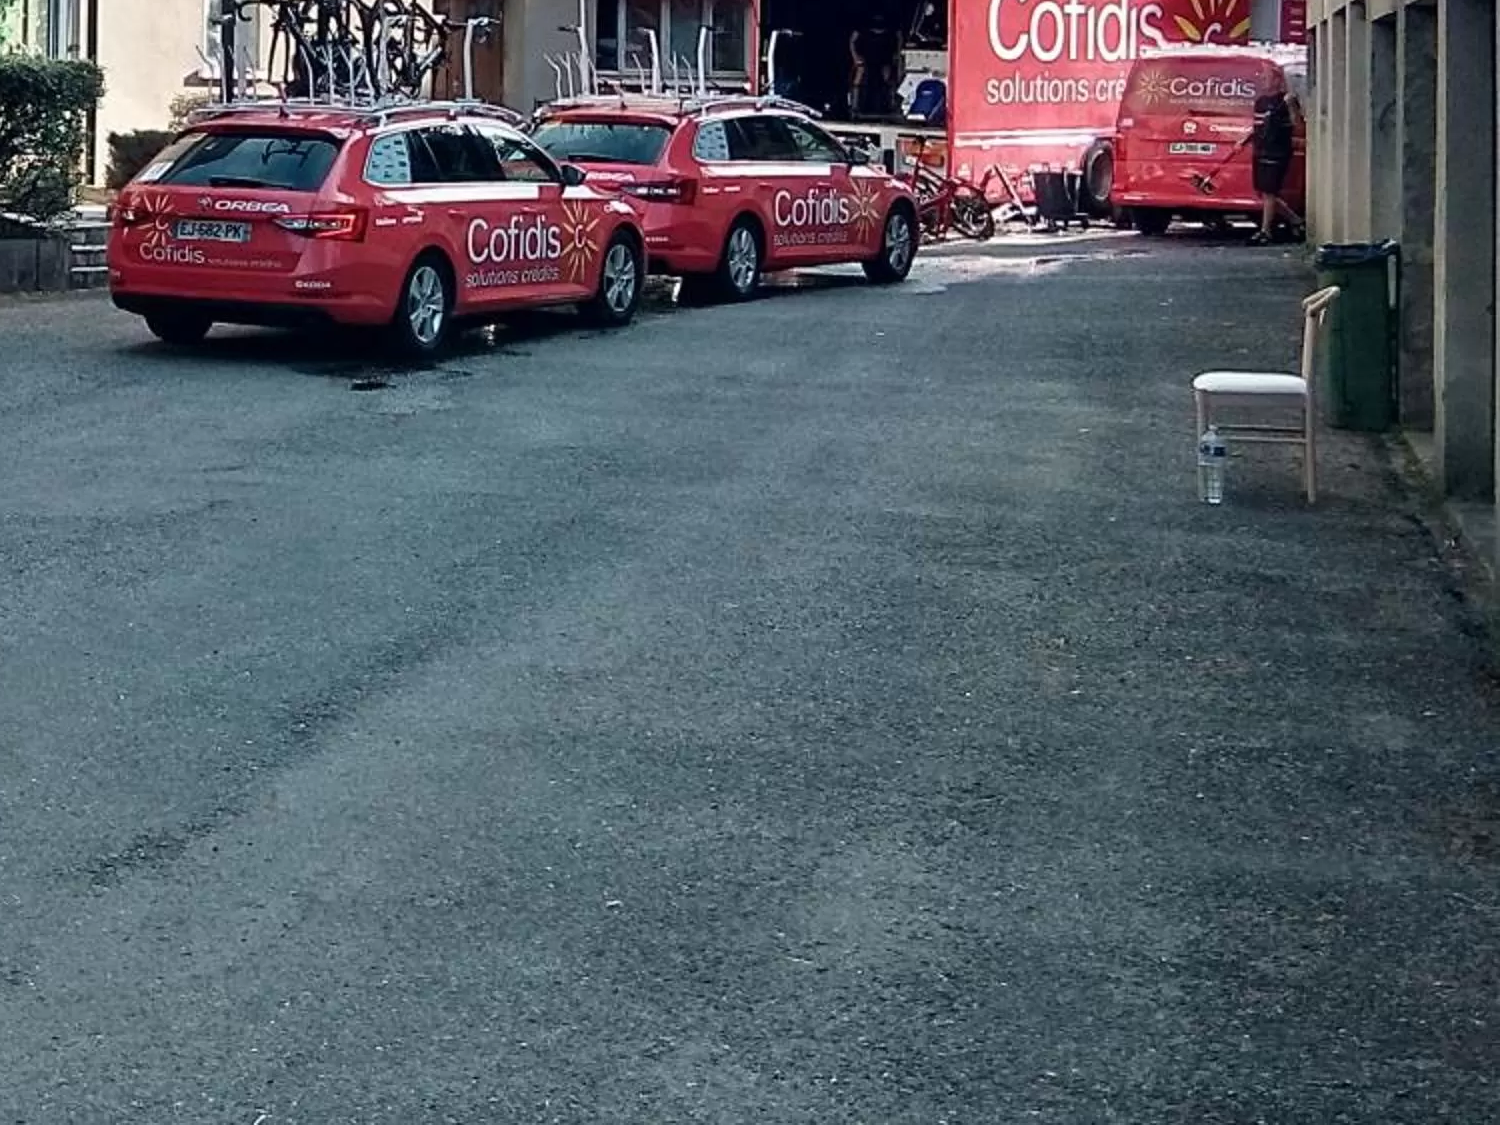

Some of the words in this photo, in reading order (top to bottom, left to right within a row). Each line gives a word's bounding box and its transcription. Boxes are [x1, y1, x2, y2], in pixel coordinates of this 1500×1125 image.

[986, 73, 1090, 105] solutions
[1169, 77, 1256, 97] Cofidis
[215, 200, 291, 213] ORBEA
[775, 188, 850, 226] Cofidis
[467, 214, 561, 263] Cofidis
[139, 242, 205, 264] Cofidis
